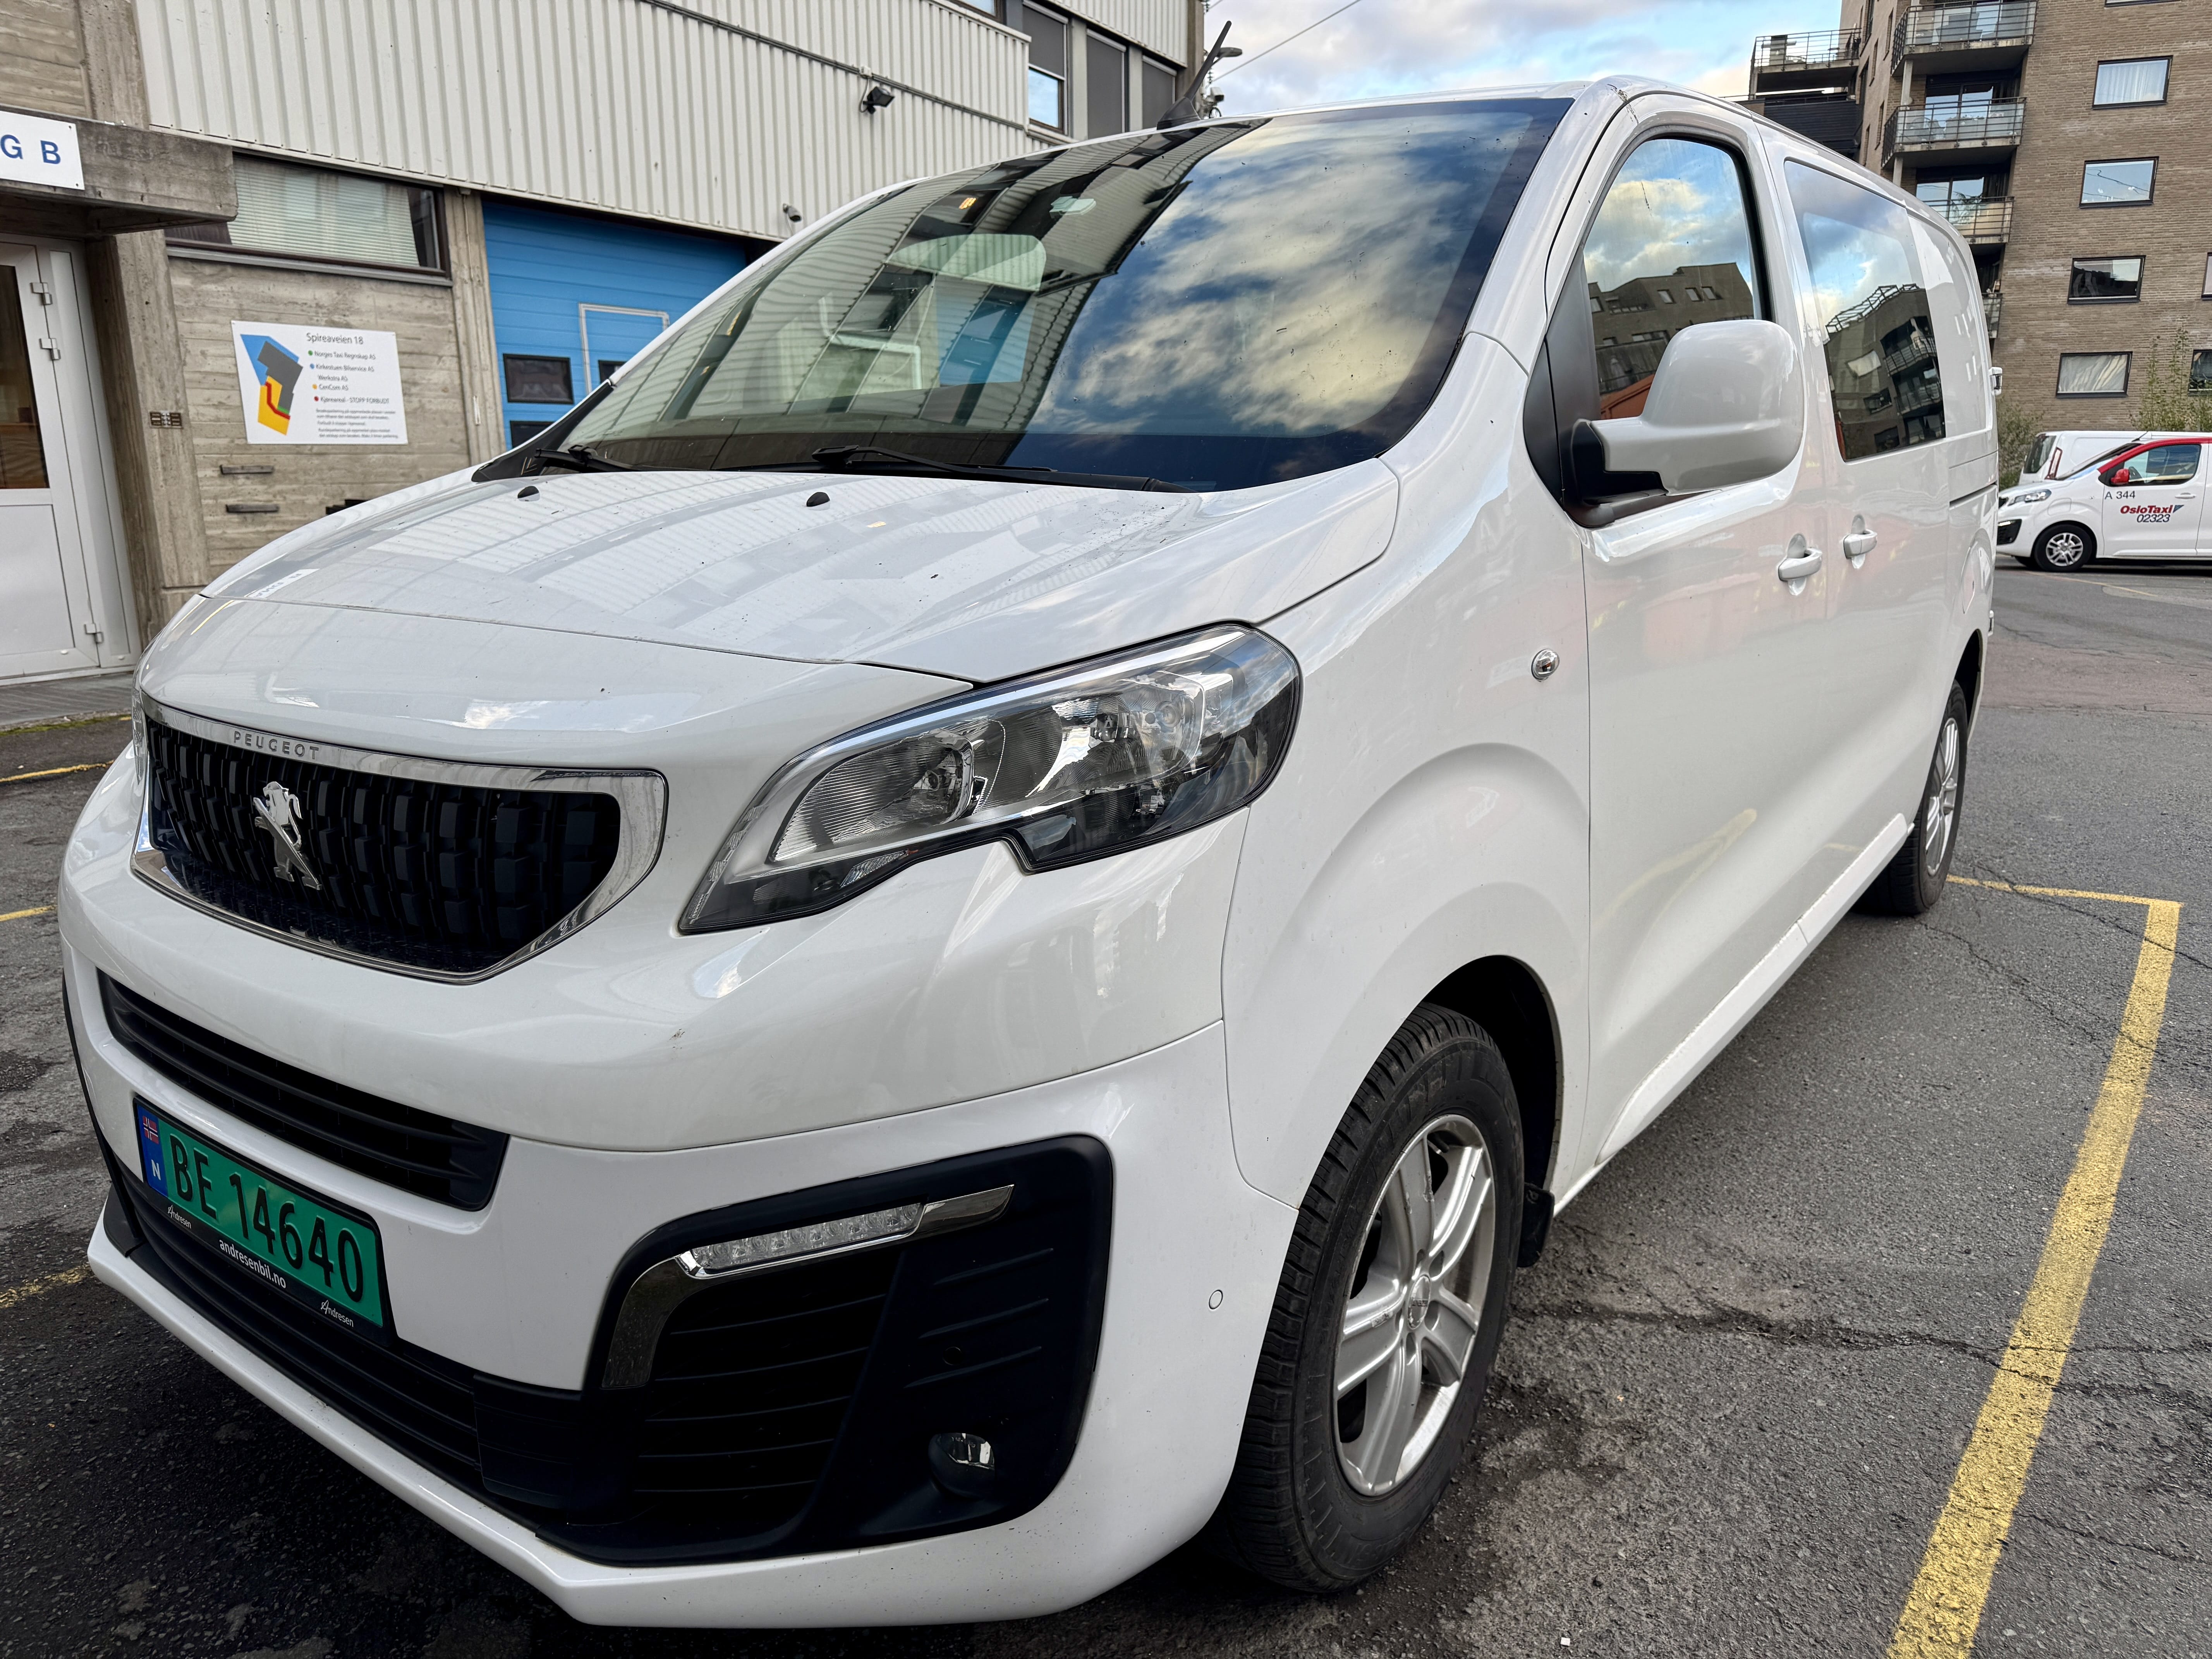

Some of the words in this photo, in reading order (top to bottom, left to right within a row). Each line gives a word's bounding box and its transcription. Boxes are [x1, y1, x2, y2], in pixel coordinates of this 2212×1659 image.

[40, 140, 61, 164] B
[306, 332, 352, 343] Spireaveien
[354, 336, 364, 344] 18
[344, 352, 368, 360] Regnskap
[2105, 491, 2112, 500] A
[2116, 491, 2135, 499] 344
[2120, 505, 2173, 514] OsloTaxi
[2137, 514, 2171, 523] 02323
[234, 731, 319, 759] PEUGEOT
[151, 1159, 161, 1180] N
[168, 1205, 192, 1229] Andresen
[170, 1133, 217, 1219] BE
[229, 1172, 364, 1303] 14640
[220, 1239, 287, 1289] andresenbil.no
[321, 1300, 354, 1327] Andresen
